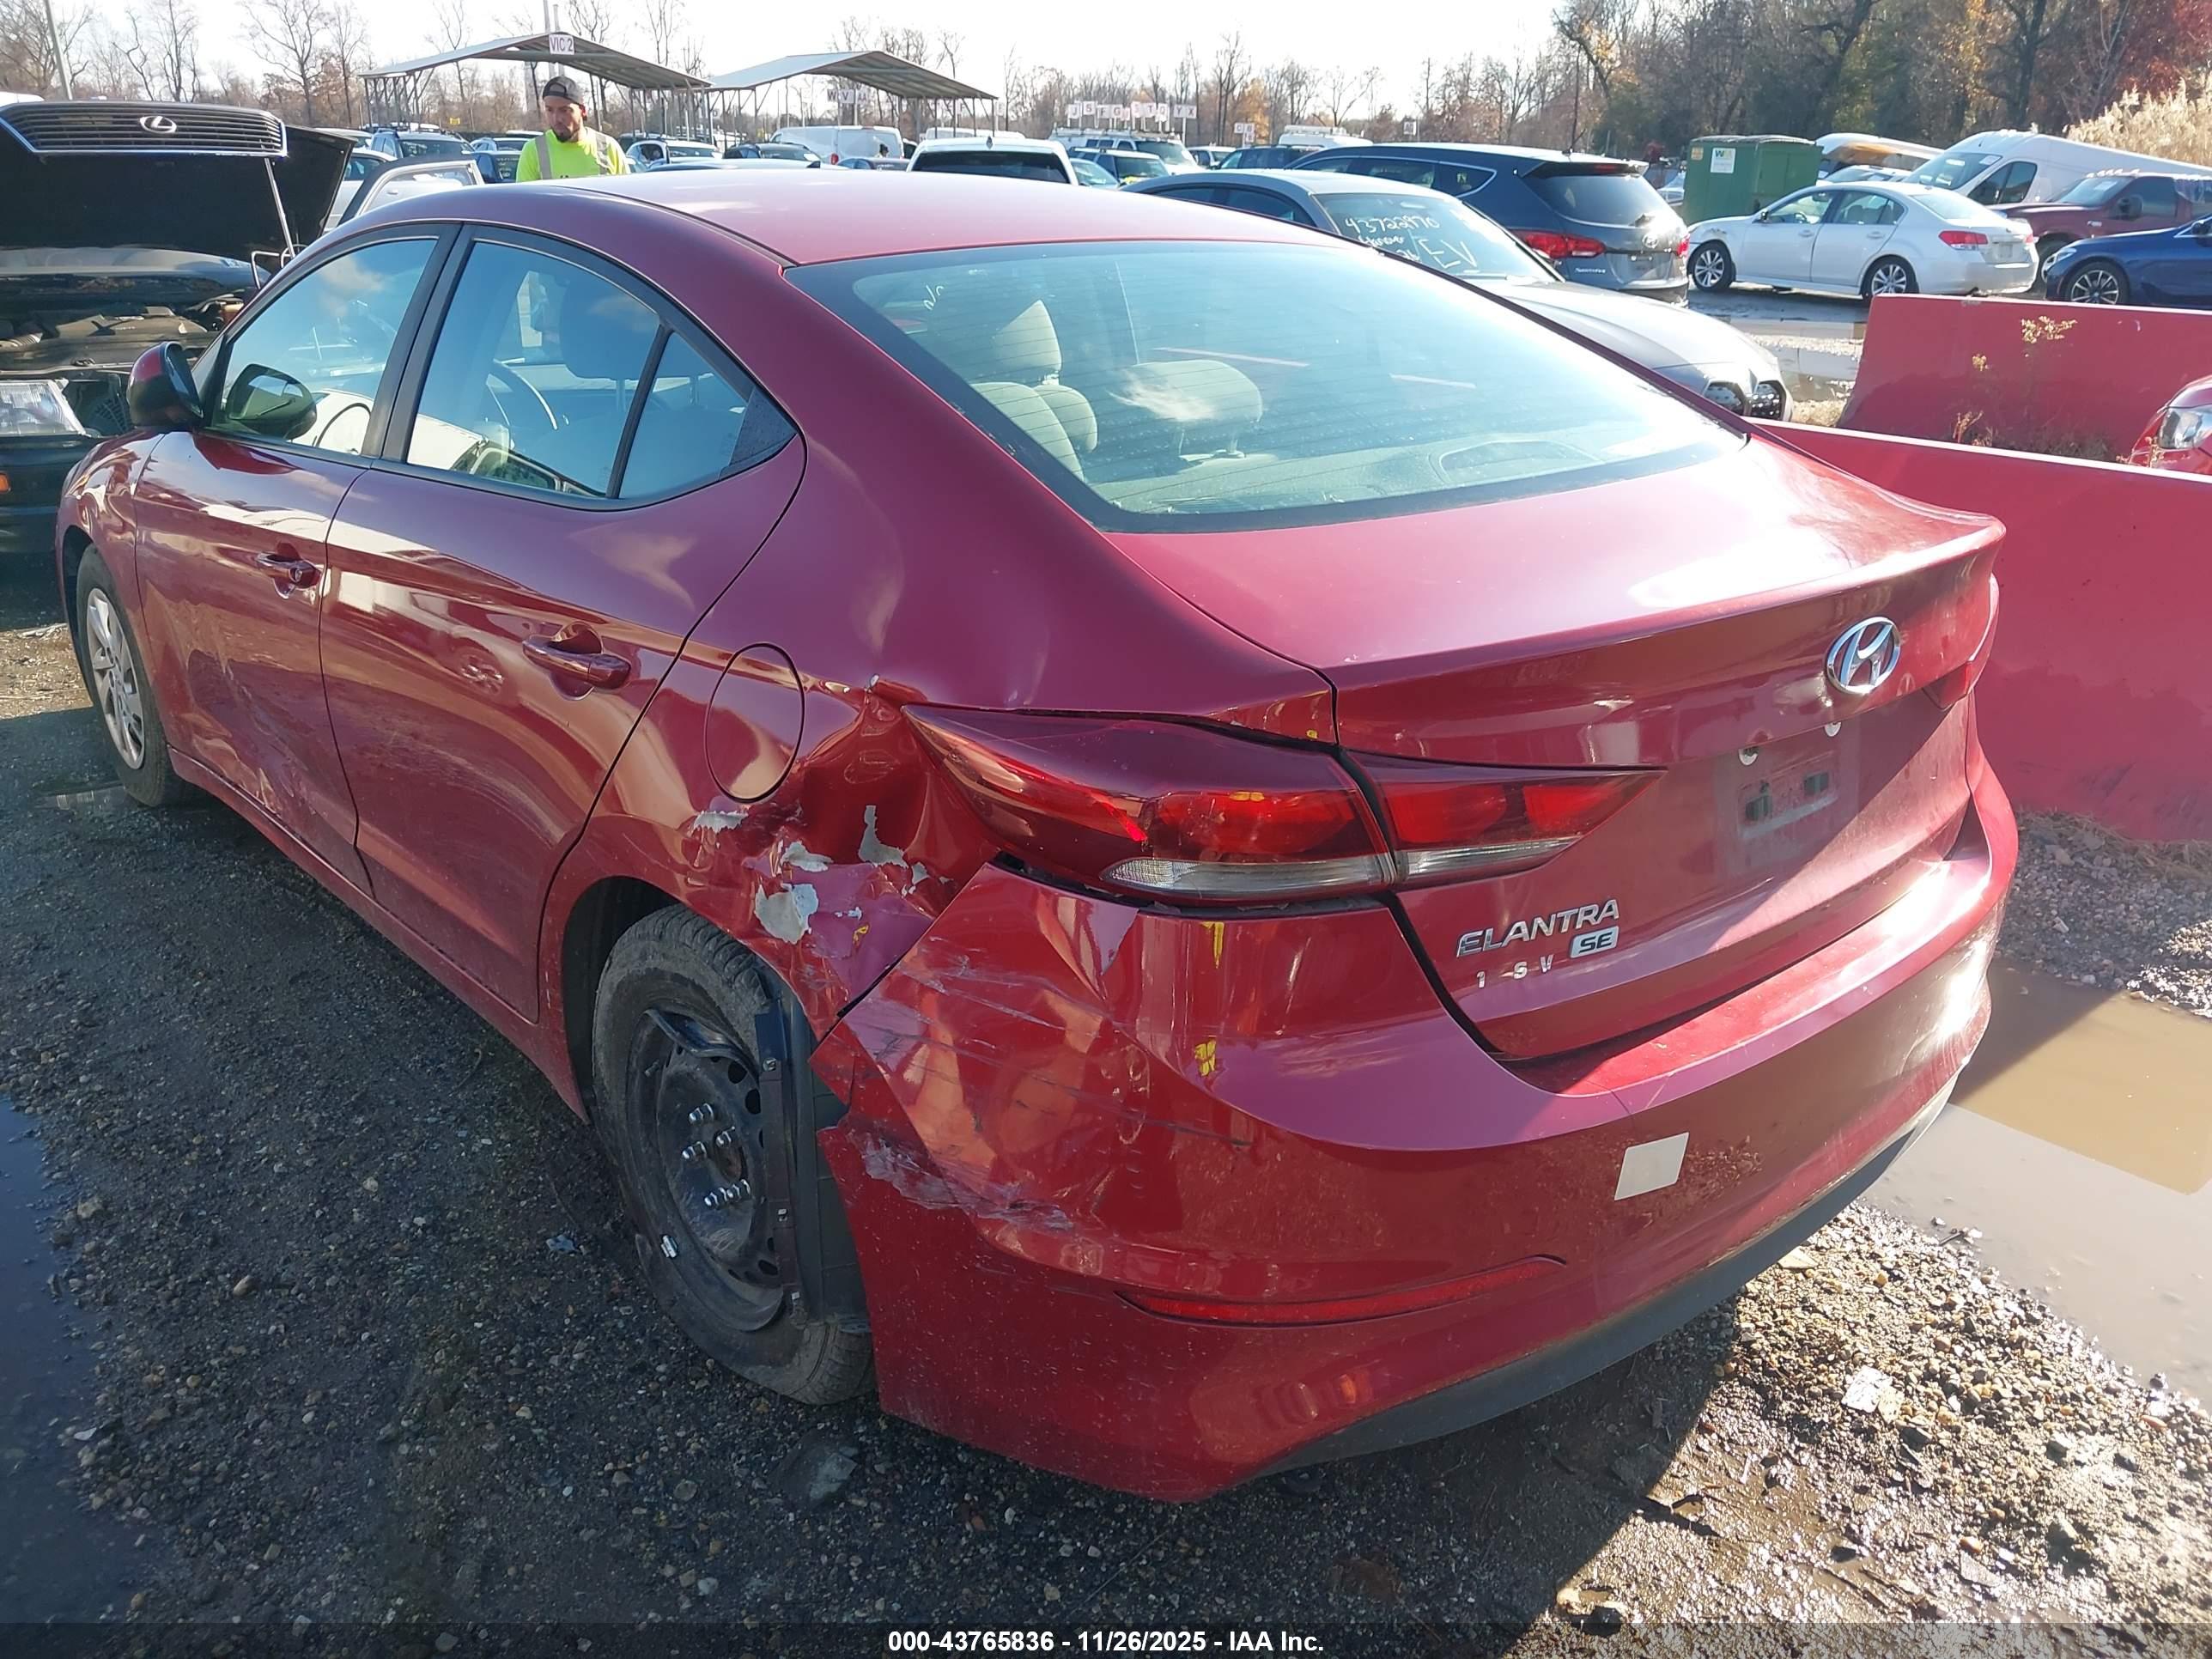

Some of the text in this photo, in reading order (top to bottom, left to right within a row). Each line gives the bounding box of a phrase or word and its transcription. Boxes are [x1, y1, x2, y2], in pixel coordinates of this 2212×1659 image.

[550, 37, 574, 52] VIC 2
[842, 91, 849, 100] V
[1455, 898, 1620, 958] ELANTRA
[1578, 931, 1614, 954] SE
[1513, 960, 1528, 980] S
[1540, 954, 1555, 973] V
